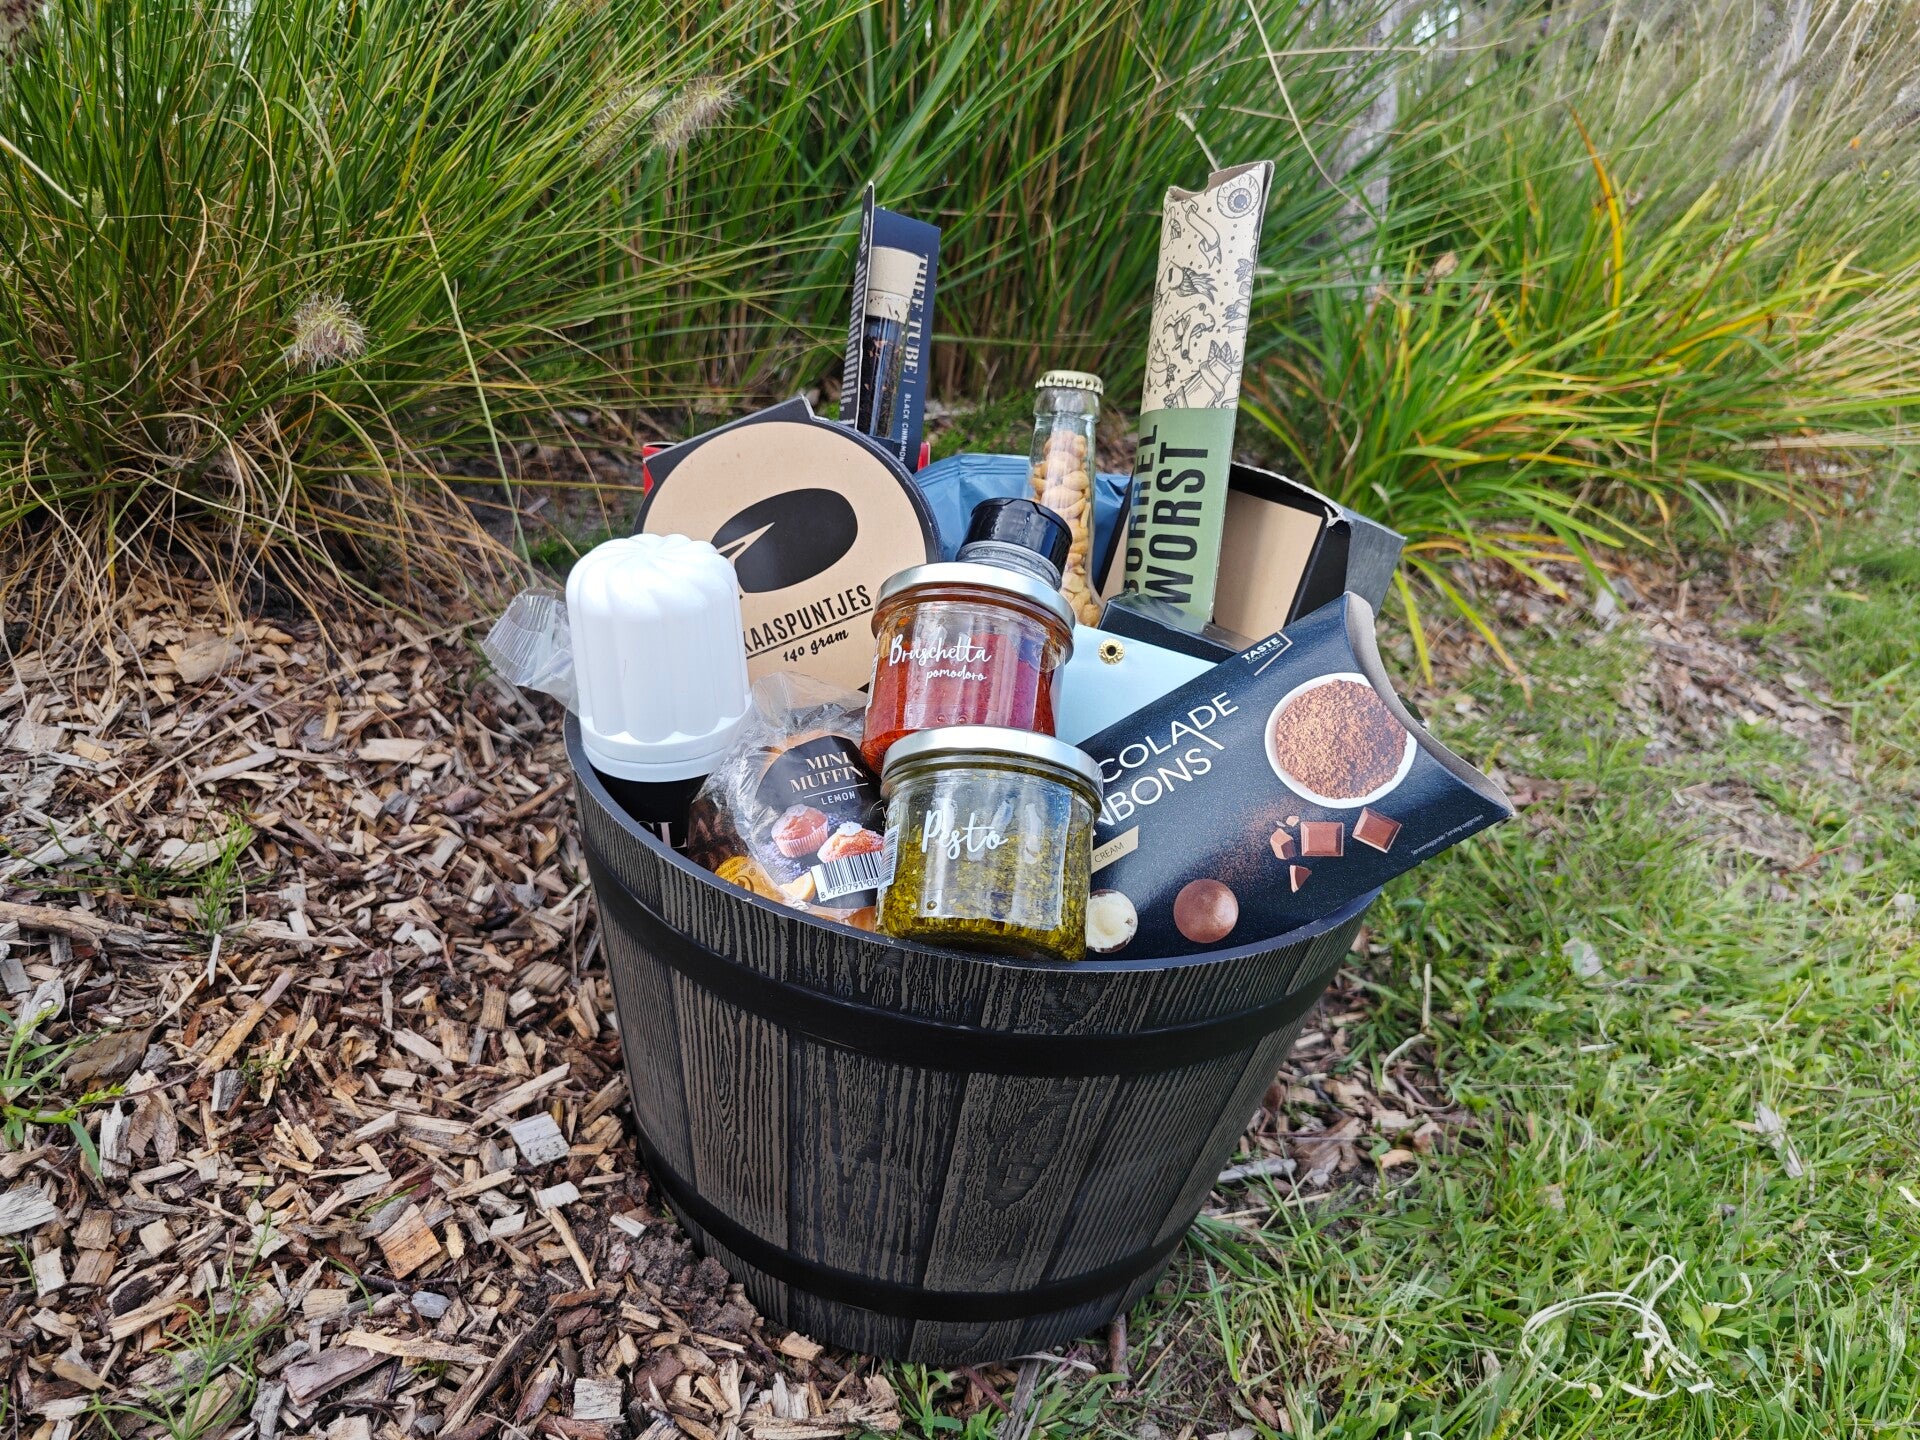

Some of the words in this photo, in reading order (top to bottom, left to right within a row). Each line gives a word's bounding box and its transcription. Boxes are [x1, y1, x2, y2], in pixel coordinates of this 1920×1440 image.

[904, 318, 922, 374] TUBE
[903, 393, 912, 420] BLACK
[899, 422, 909, 462] CINNAMON
[1145, 441, 1209, 604] WORST
[783, 646, 805, 662] 140
[810, 629, 849, 655] gram
[889, 633, 992, 667] Bruschetta
[1241, 637, 1281, 661] TASTE
[925, 664, 987, 685] pomodoro
[805, 751, 850, 771] MINI
[821, 790, 856, 806] LEMON
[921, 808, 1009, 860] Pesto
[1094, 841, 1125, 863] CREAM
[821, 891, 826, 899] 8
[832, 881, 864, 895] 720791
